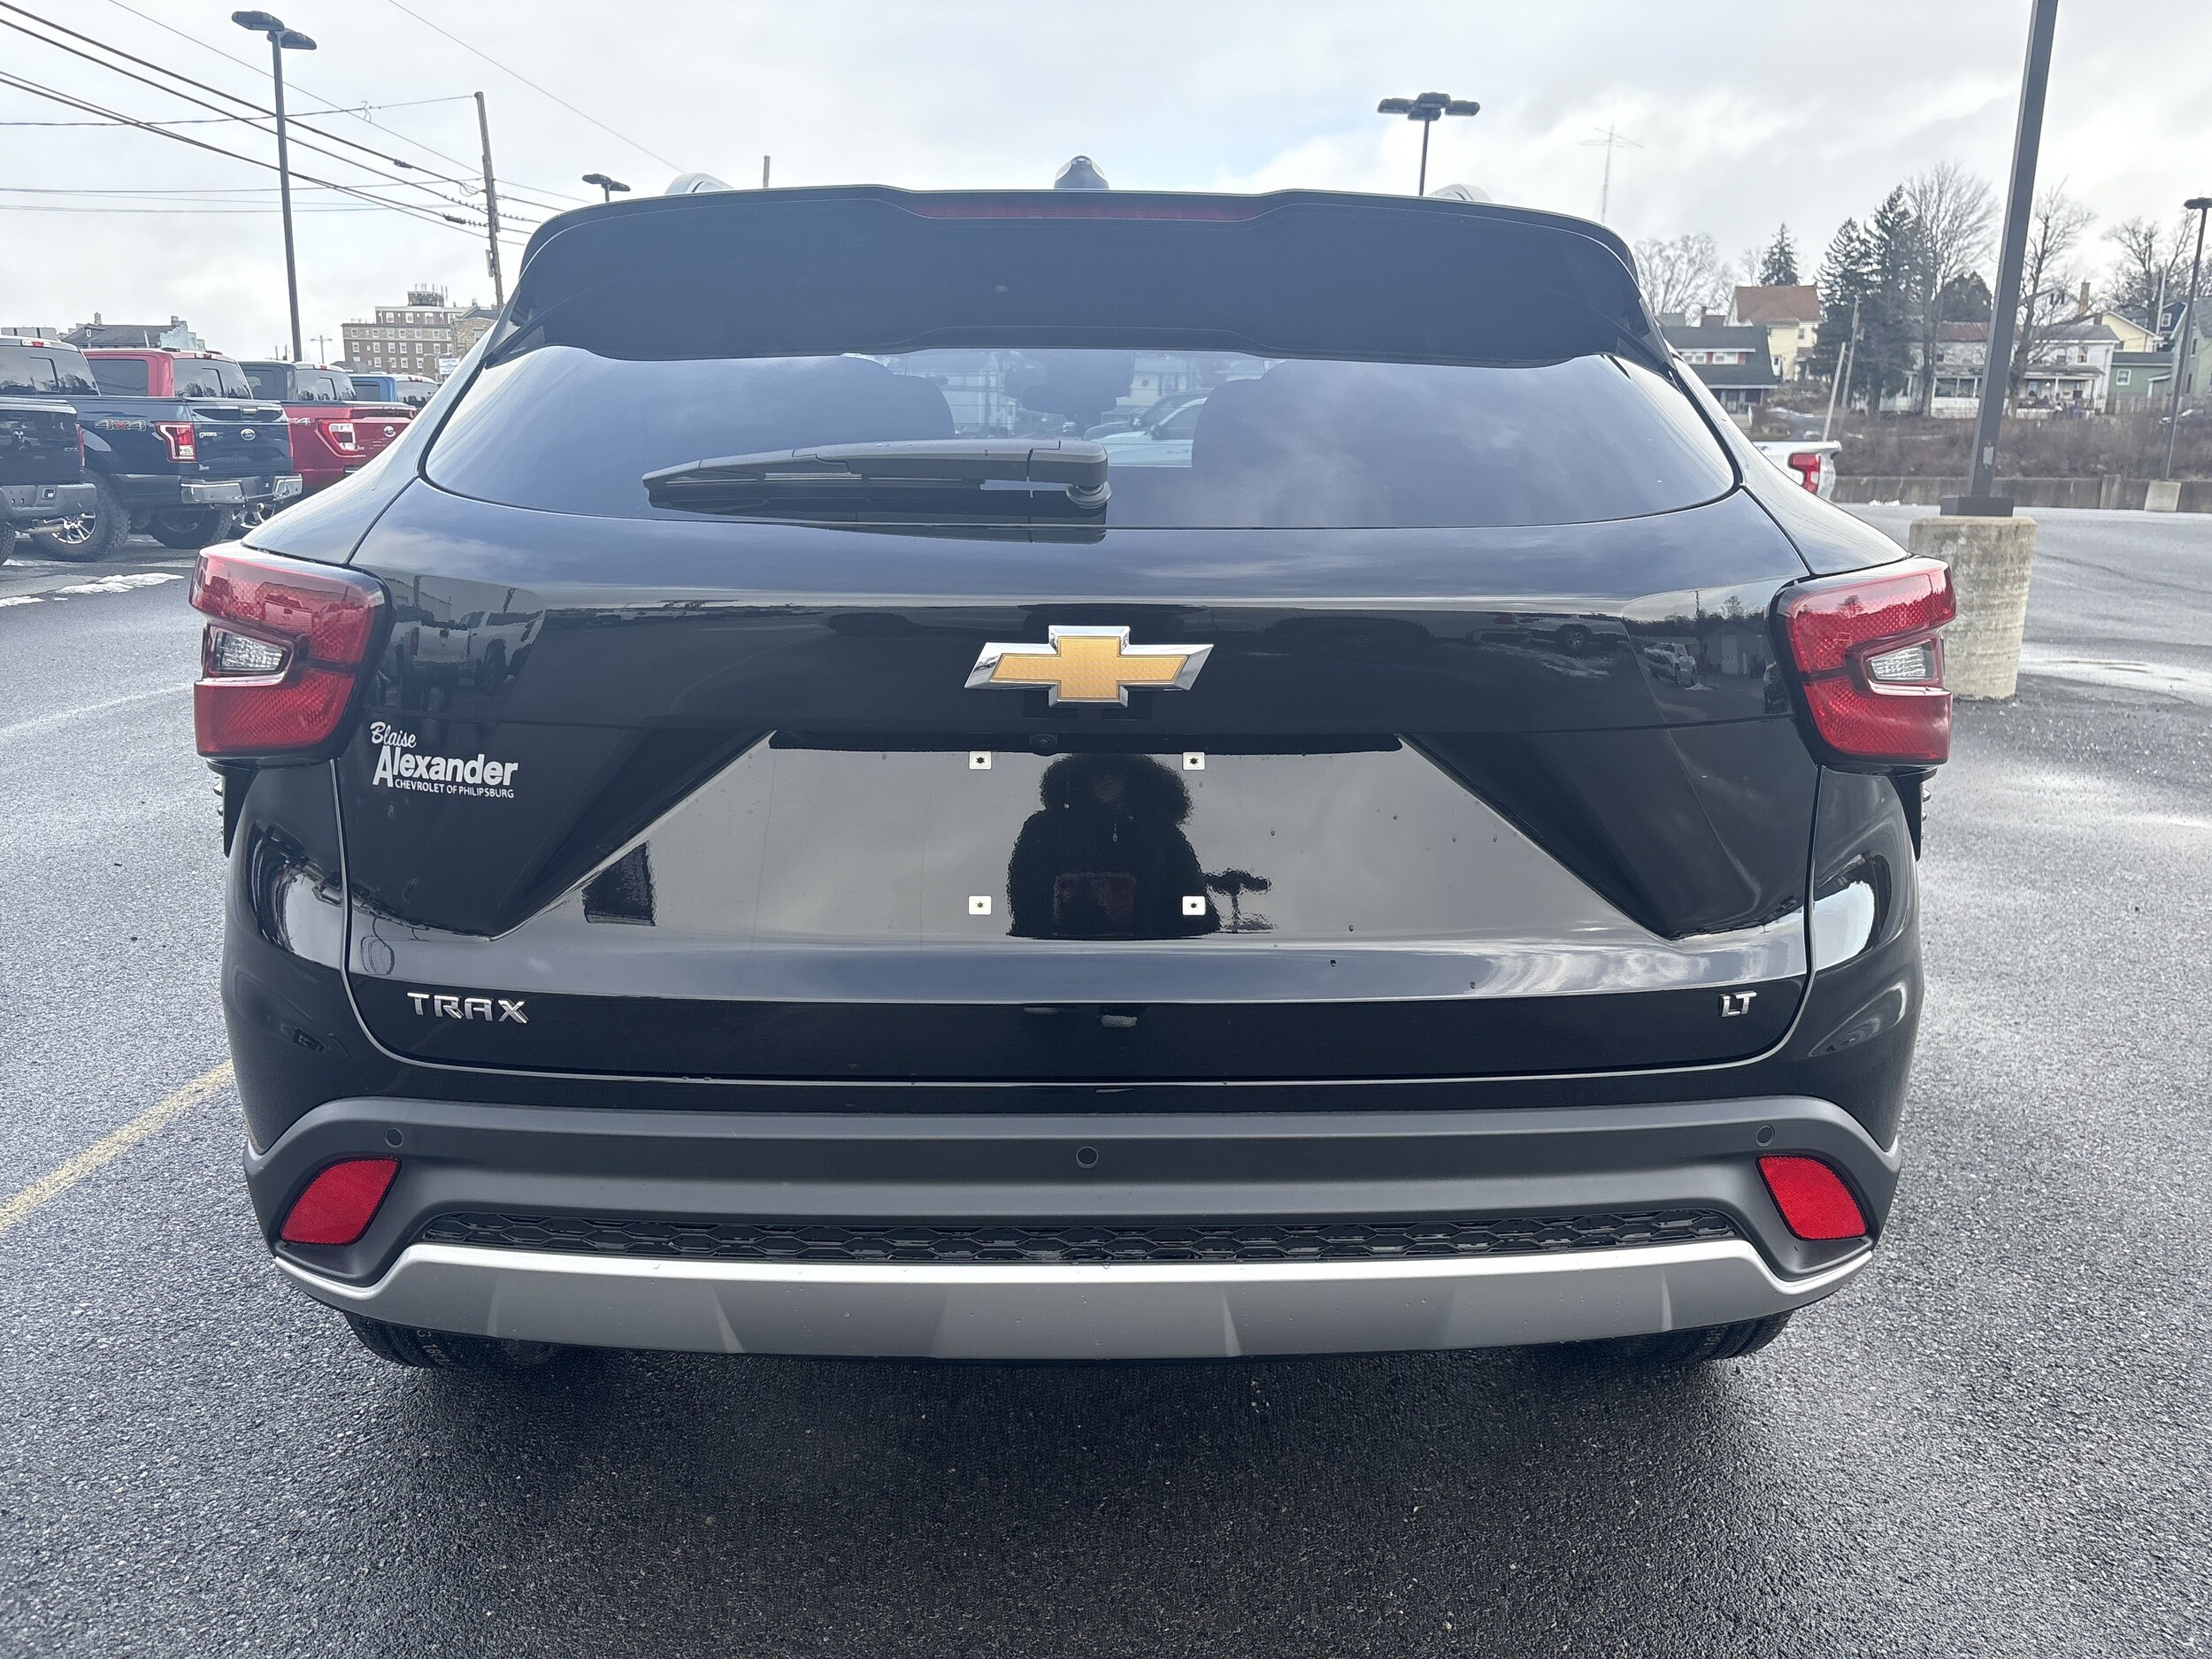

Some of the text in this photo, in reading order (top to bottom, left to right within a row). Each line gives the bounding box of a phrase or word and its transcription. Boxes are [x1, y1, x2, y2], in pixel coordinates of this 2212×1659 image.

[370, 721, 417, 748] Blaise
[372, 745, 518, 787] Alexander
[395, 779, 515, 798] CHEVROLET OF PHILIPSBURG
[407, 992, 528, 1024] TRAX
[1720, 991, 1757, 1018] LT
